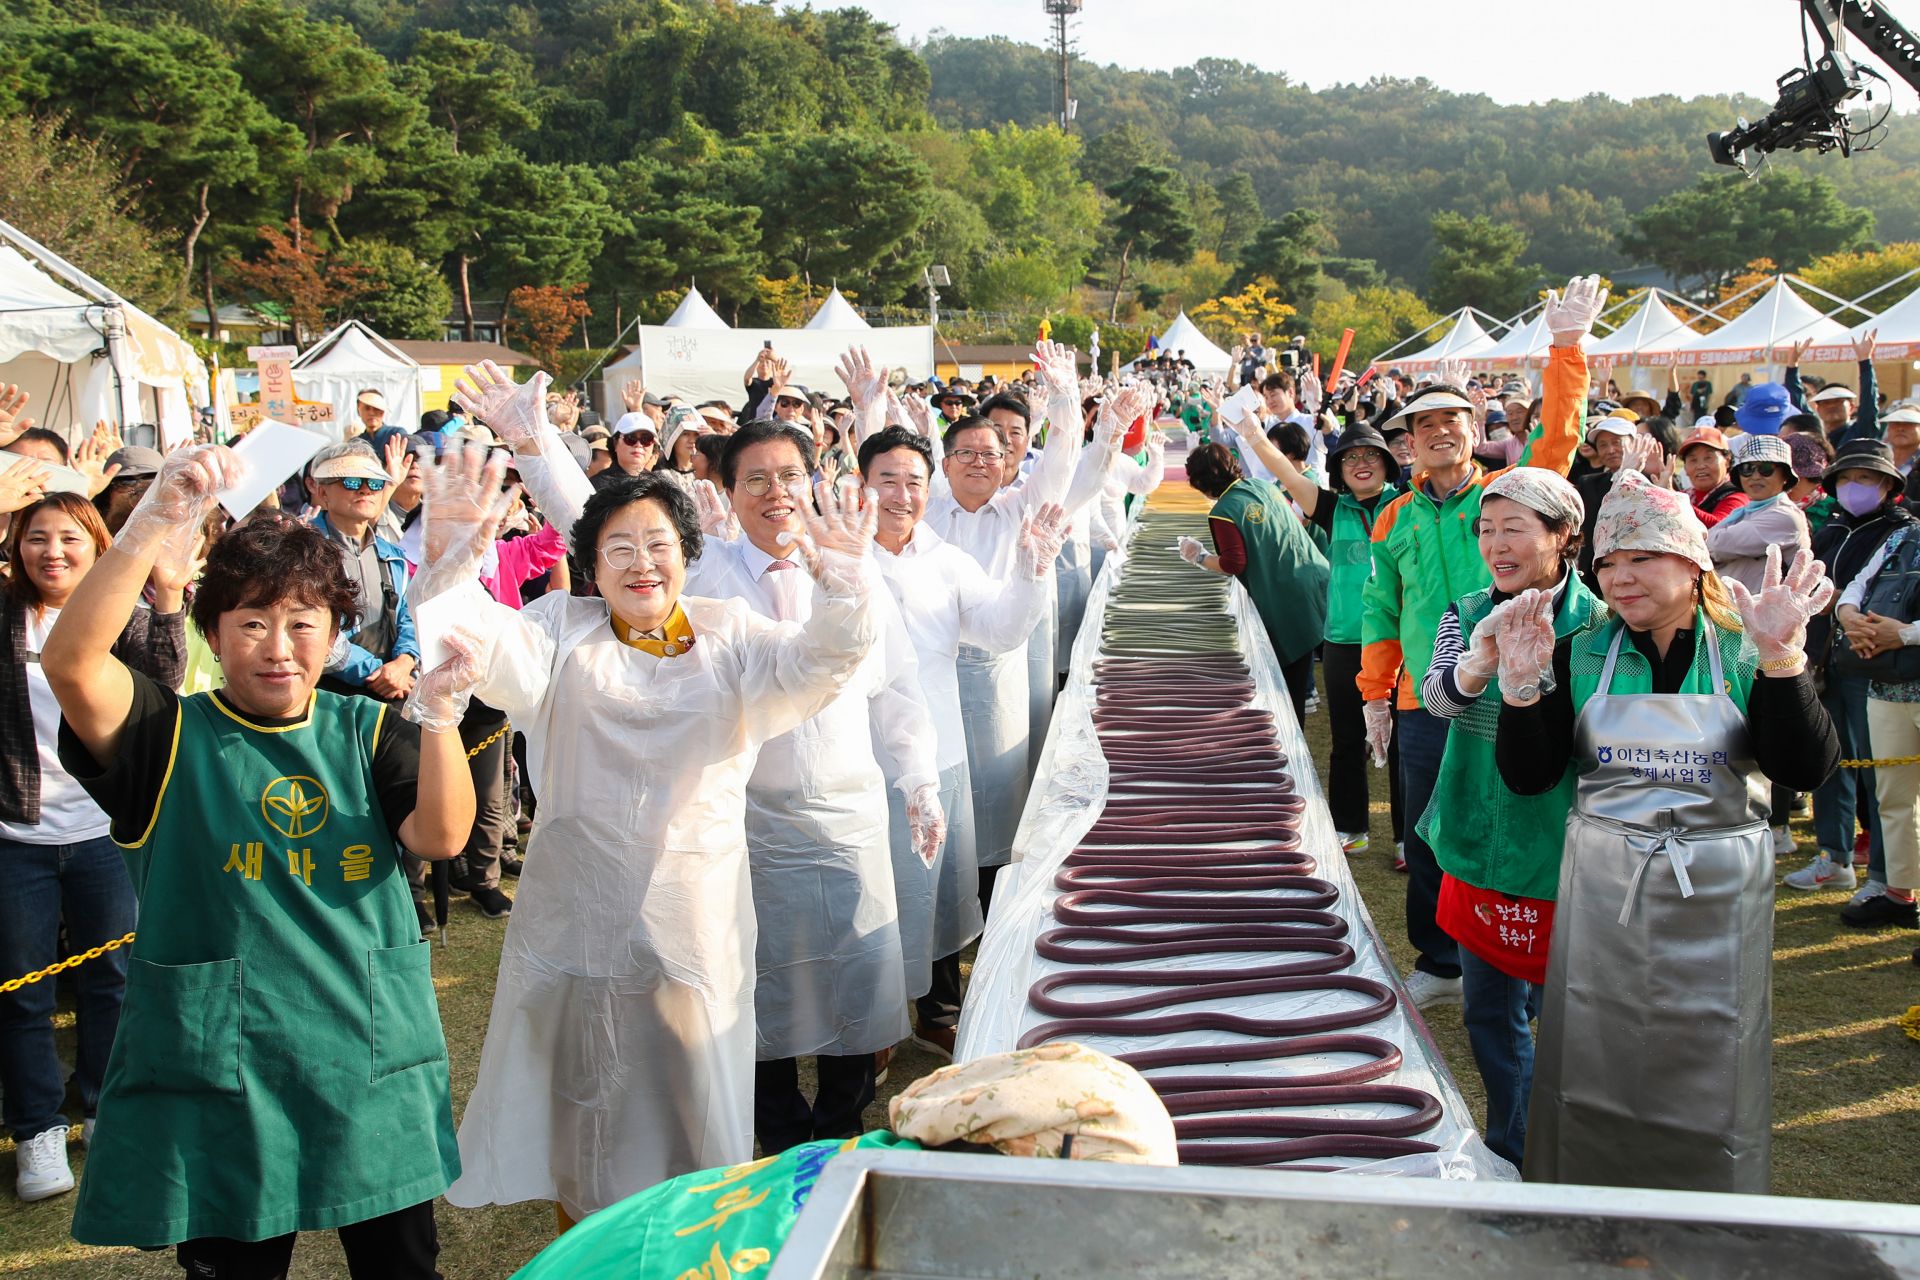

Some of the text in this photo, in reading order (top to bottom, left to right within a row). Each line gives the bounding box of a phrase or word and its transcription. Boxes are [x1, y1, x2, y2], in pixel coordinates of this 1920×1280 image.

[1617, 748, 1728, 765] 이천축산농협
[1628, 766, 1713, 784] 경제사업장
[223, 841, 374, 886] 새마을
[1495, 903, 1539, 923] 장호원
[1499, 924, 1536, 954] 복숭아
